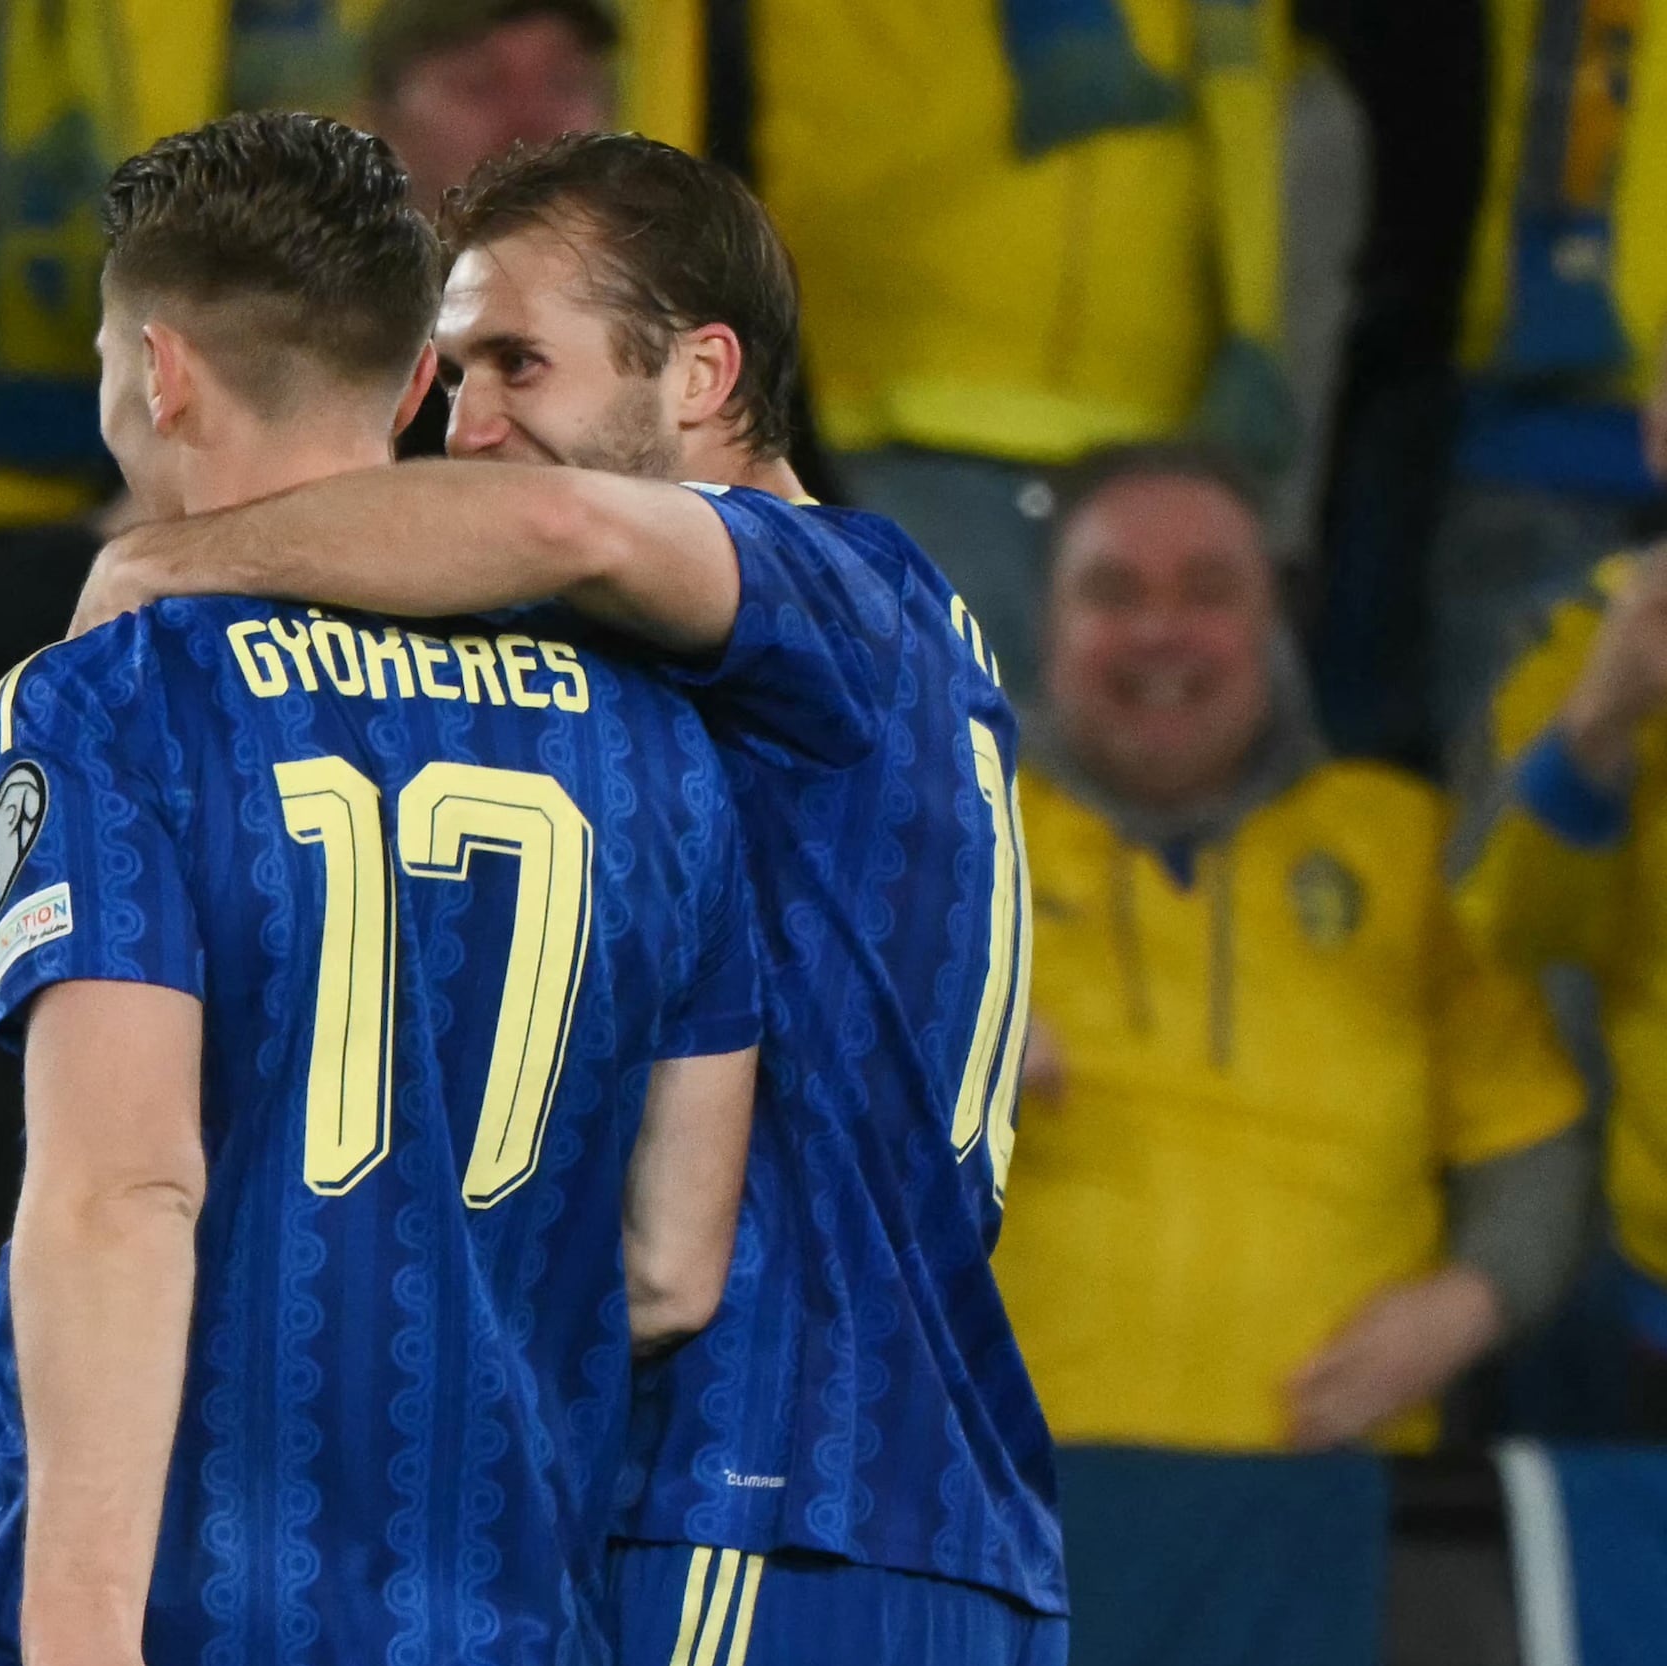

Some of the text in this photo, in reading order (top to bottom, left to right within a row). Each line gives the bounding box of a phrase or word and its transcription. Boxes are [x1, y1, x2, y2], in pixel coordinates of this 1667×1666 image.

[226, 608, 590, 714] GYÖKERES
[272, 755, 594, 1210] 17
[950, 717, 1034, 1210] 1
